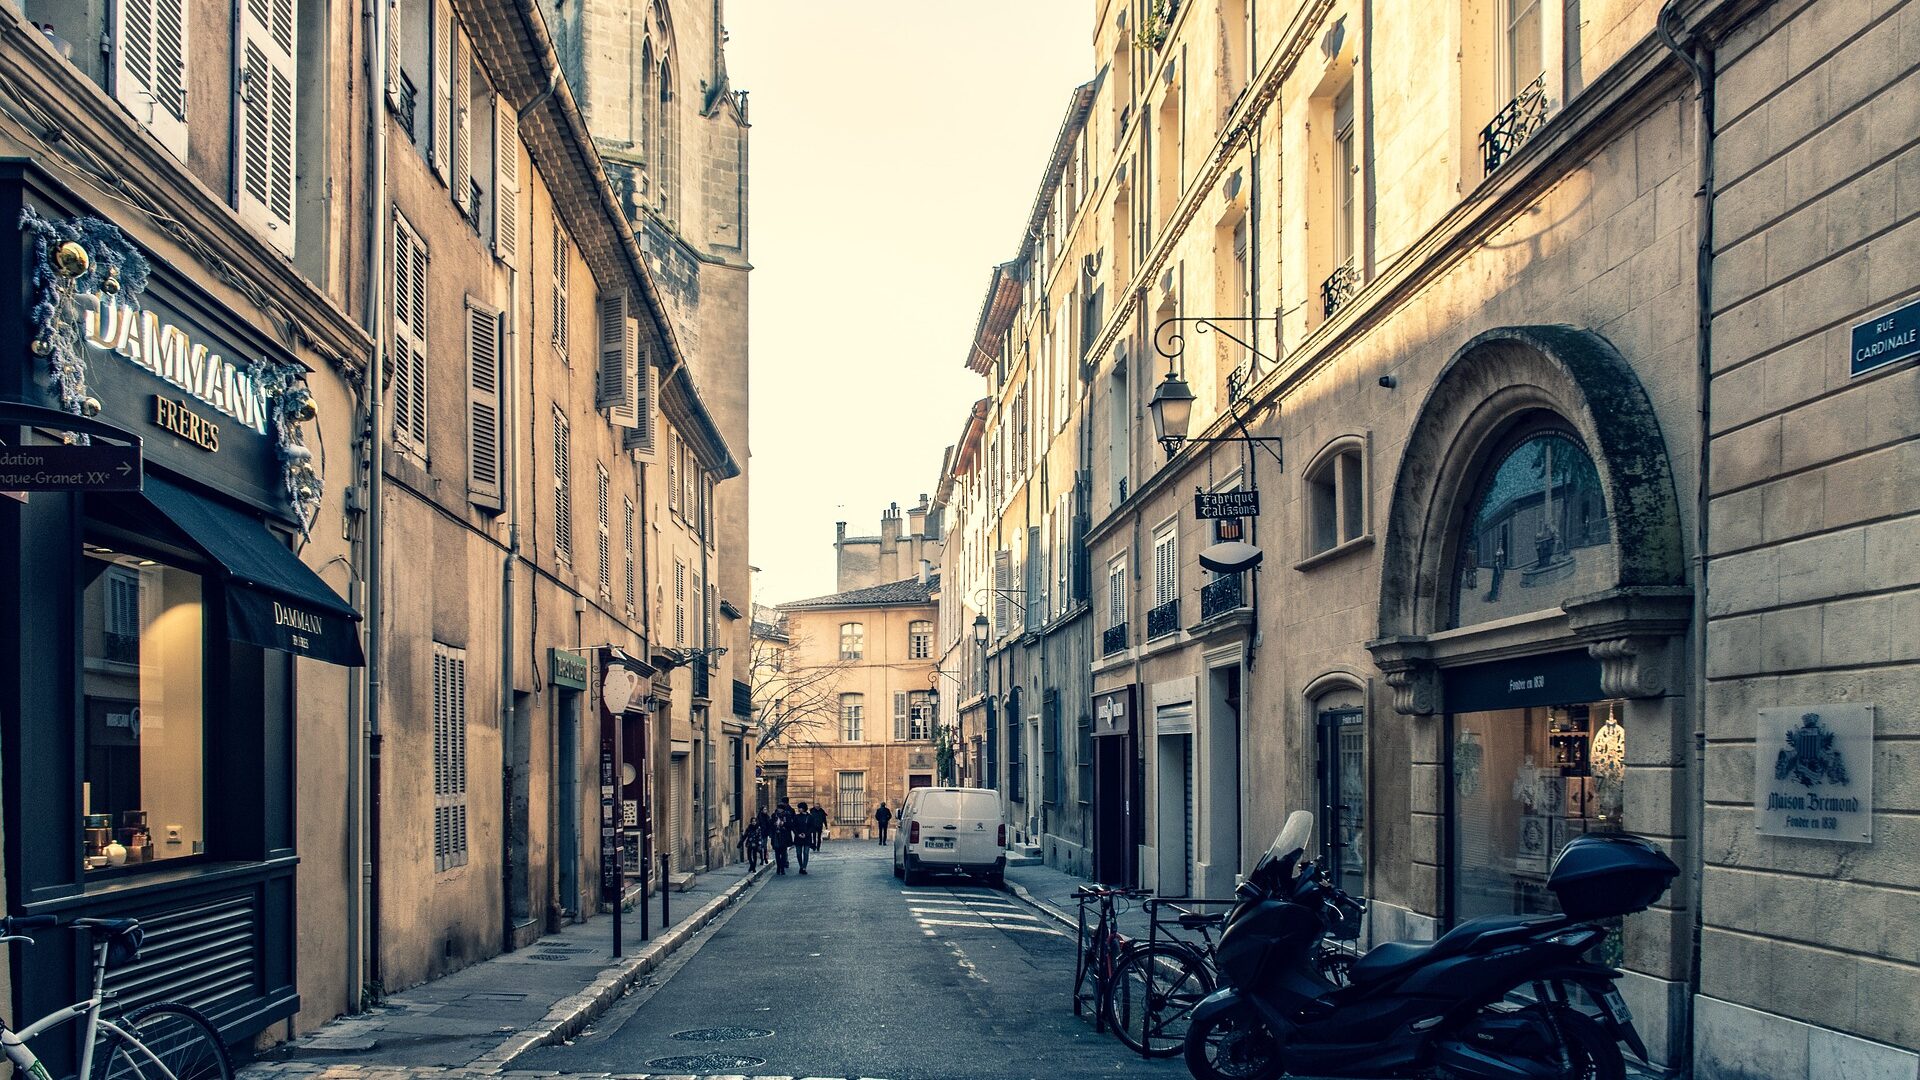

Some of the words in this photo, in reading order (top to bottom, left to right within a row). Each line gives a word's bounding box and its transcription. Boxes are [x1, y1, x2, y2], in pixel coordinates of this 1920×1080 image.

[1876, 318, 1895, 334] RUE
[1856, 329, 1917, 362] CARDINALE
[84, 294, 267, 436] DAMMANN
[156, 394, 219, 453] FRÈRES
[0, 452, 44, 466] dation
[1201, 493, 1254, 507] Fabrique
[273, 601, 322, 635] DAMMANN
[1766, 792, 1805, 811] Maison
